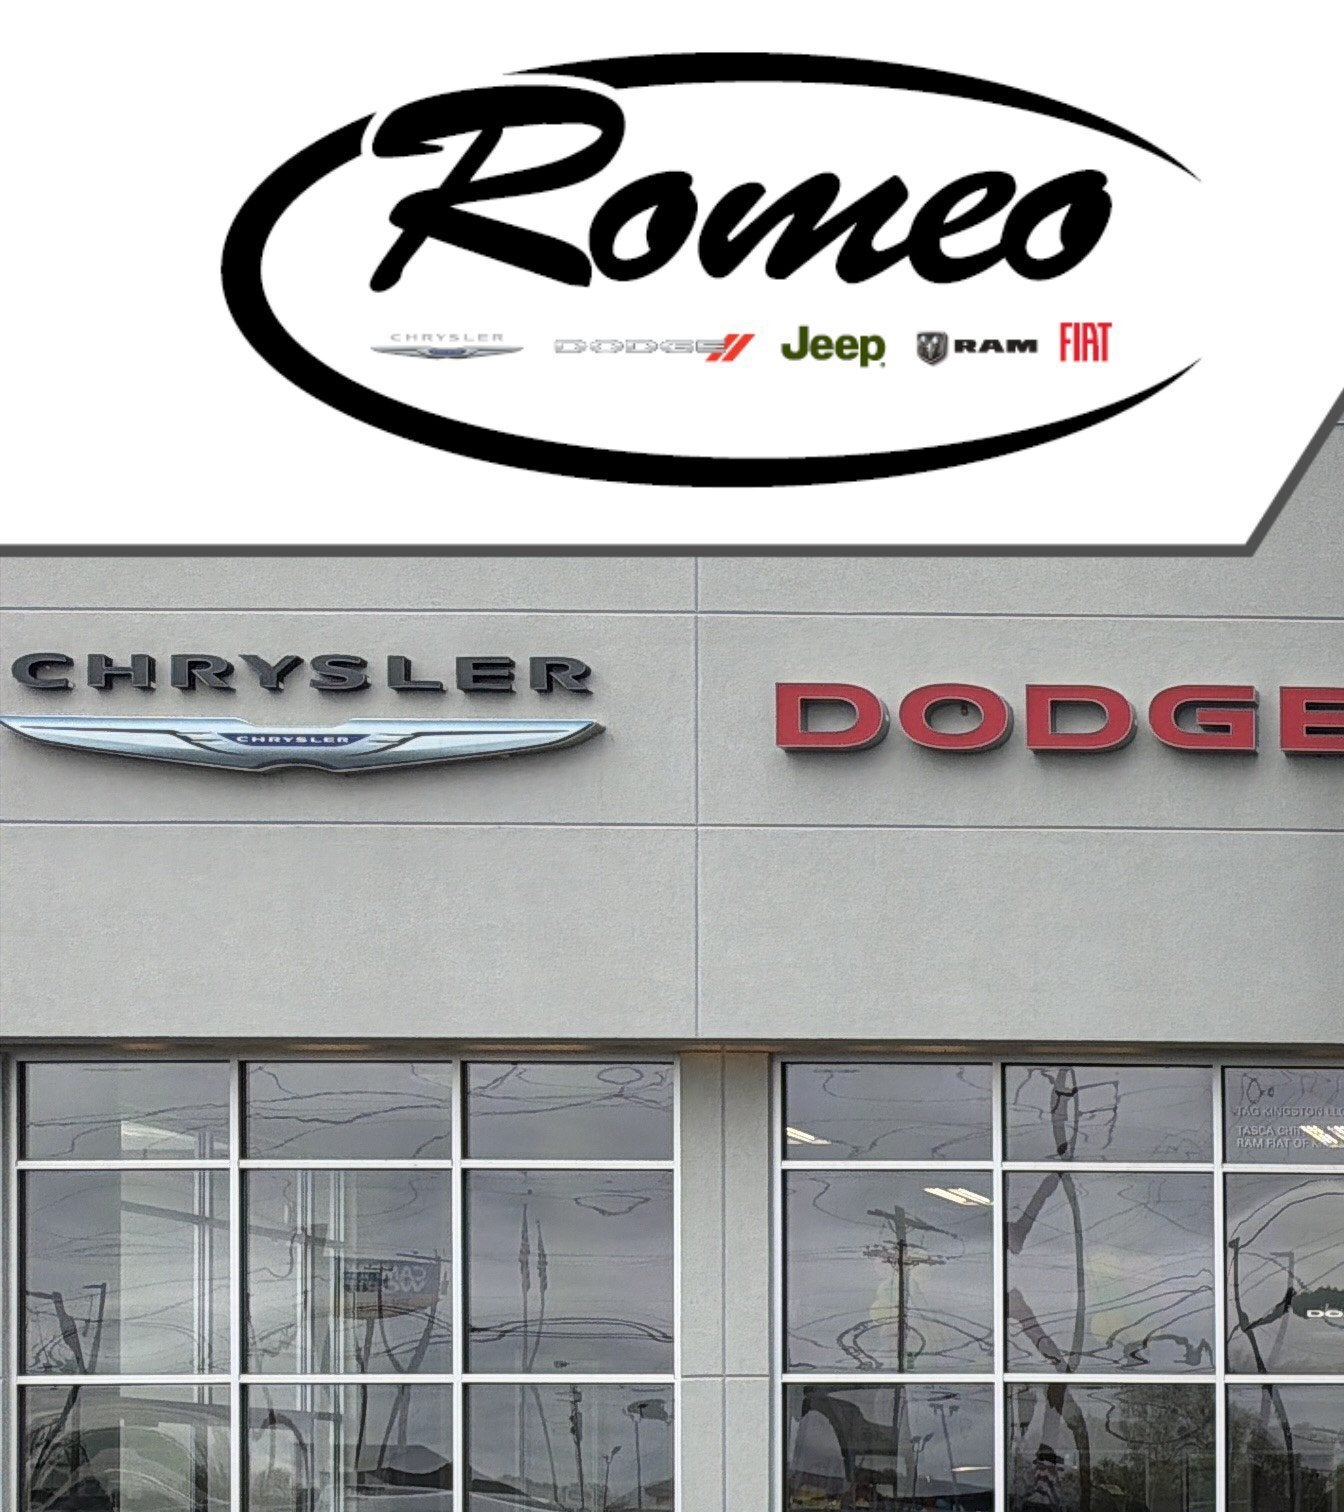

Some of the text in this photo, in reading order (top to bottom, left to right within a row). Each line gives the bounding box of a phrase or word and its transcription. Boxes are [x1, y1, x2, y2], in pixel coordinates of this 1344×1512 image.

[11, 652, 594, 694] CHRYSLER
[236, 735, 350, 744] CHRYSLER
[1237, 1125, 1275, 1137] TASCA
